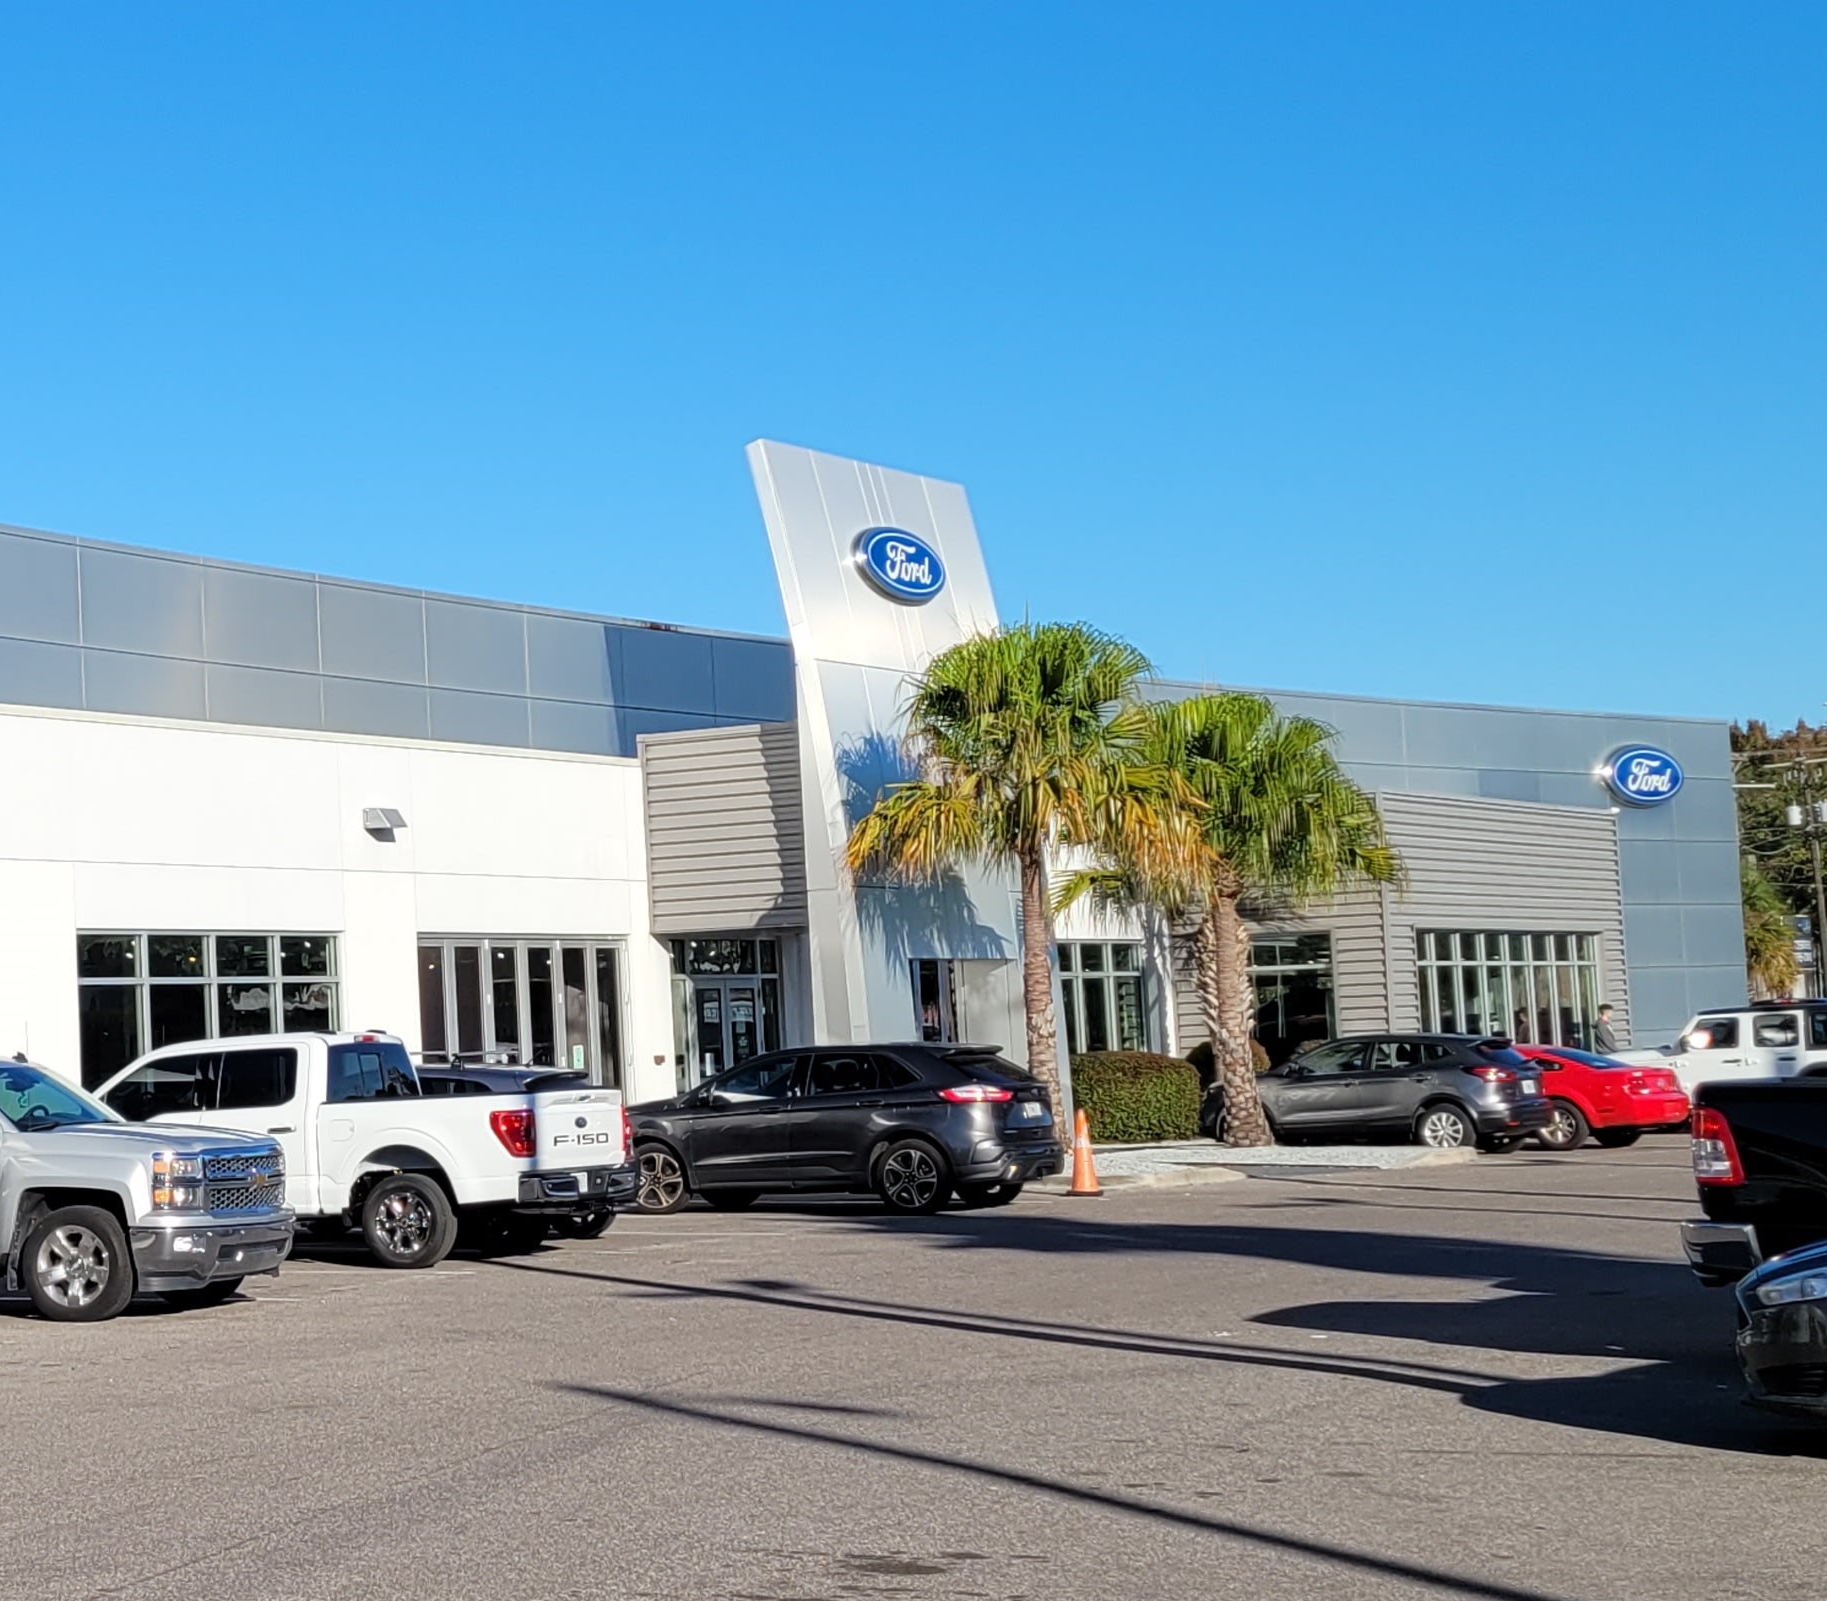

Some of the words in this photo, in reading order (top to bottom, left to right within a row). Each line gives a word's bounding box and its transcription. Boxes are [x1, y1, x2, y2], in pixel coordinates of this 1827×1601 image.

[885, 541, 932, 585] Ford
[1628, 758, 1672, 792] Ford
[553, 1133, 609, 1147] F-150
